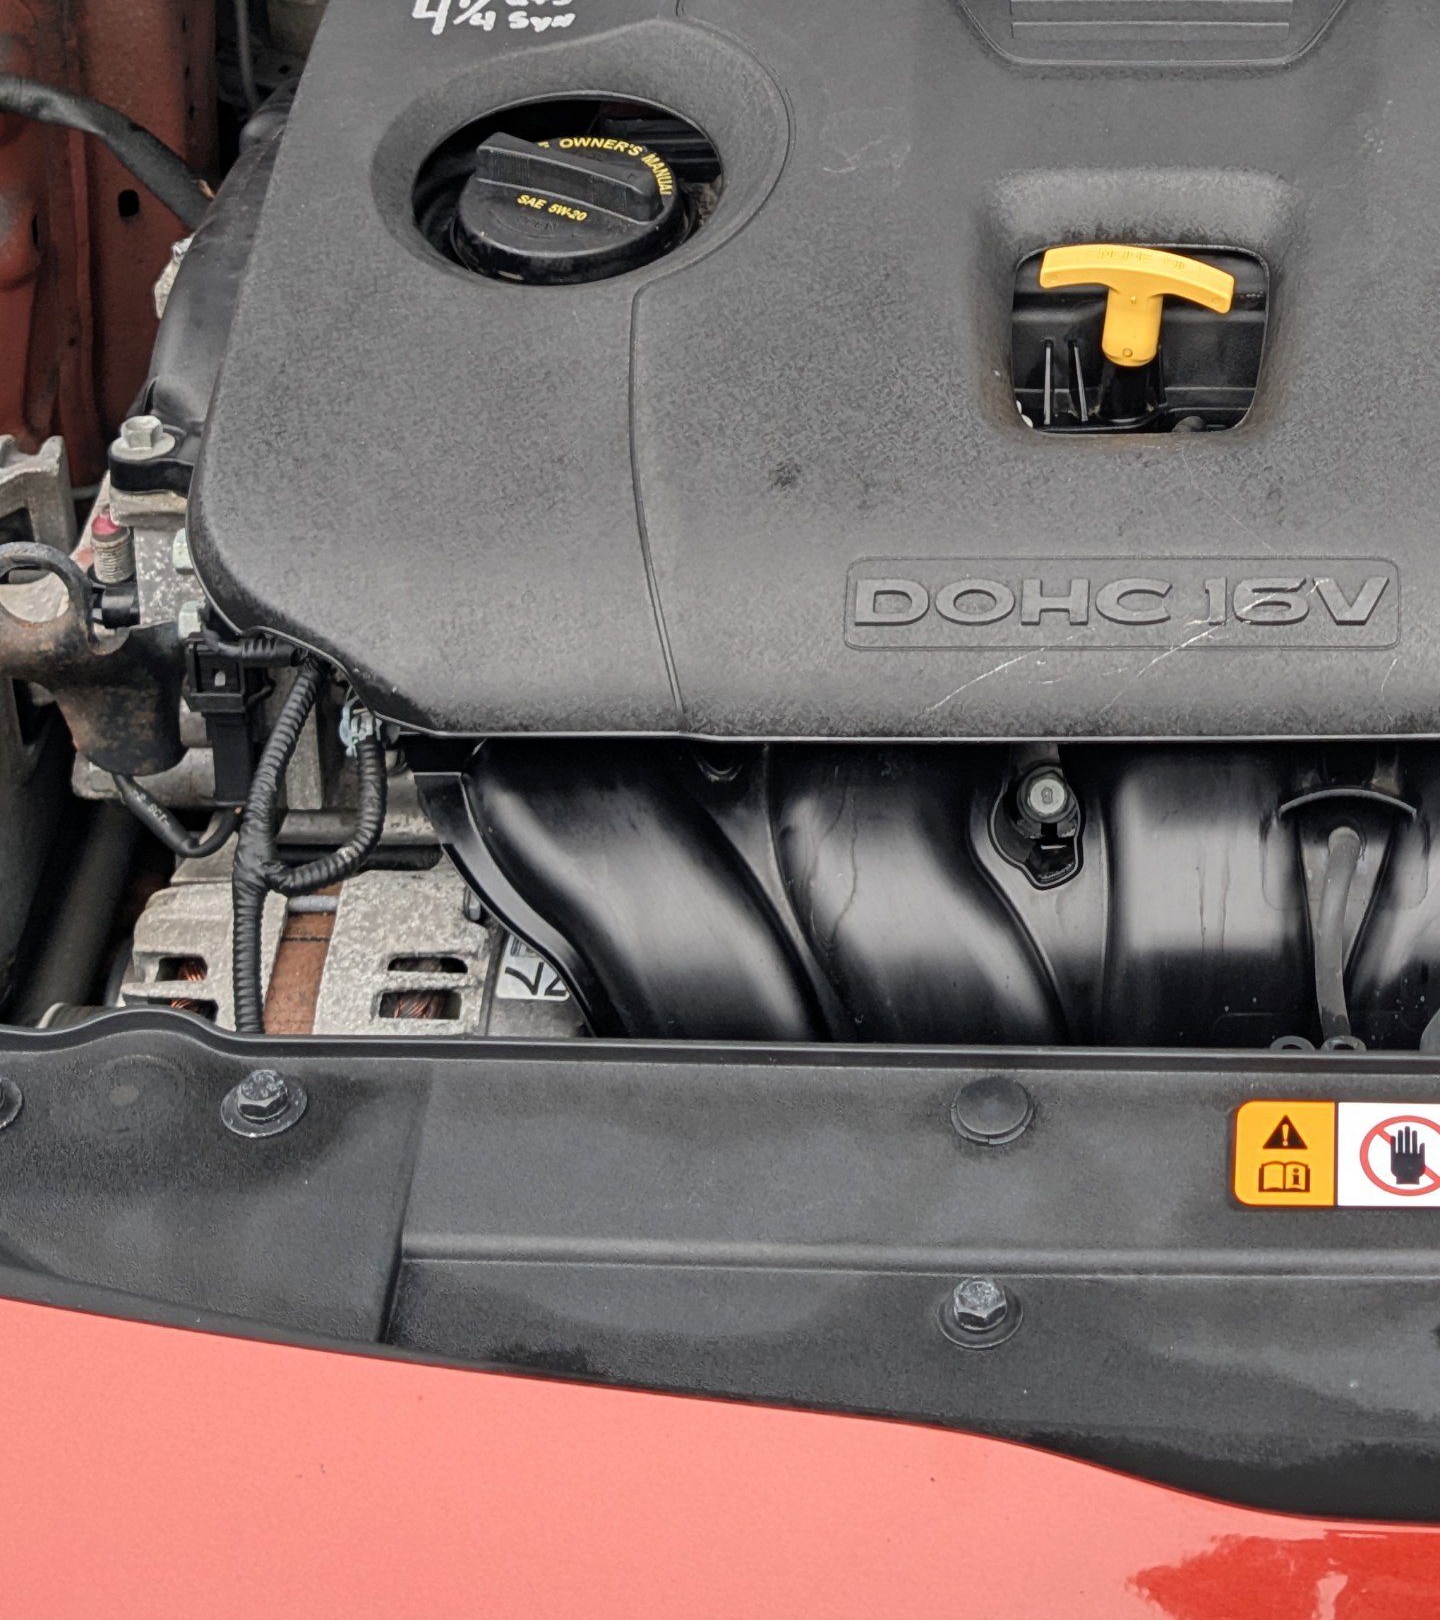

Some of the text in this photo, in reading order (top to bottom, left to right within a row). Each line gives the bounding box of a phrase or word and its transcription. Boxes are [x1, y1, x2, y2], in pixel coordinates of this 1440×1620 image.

[559, 137, 643, 157] OWNER'S
[517, 194, 587, 222] SAE 5W-20
[854, 577, 1390, 627] DOHC 16V
